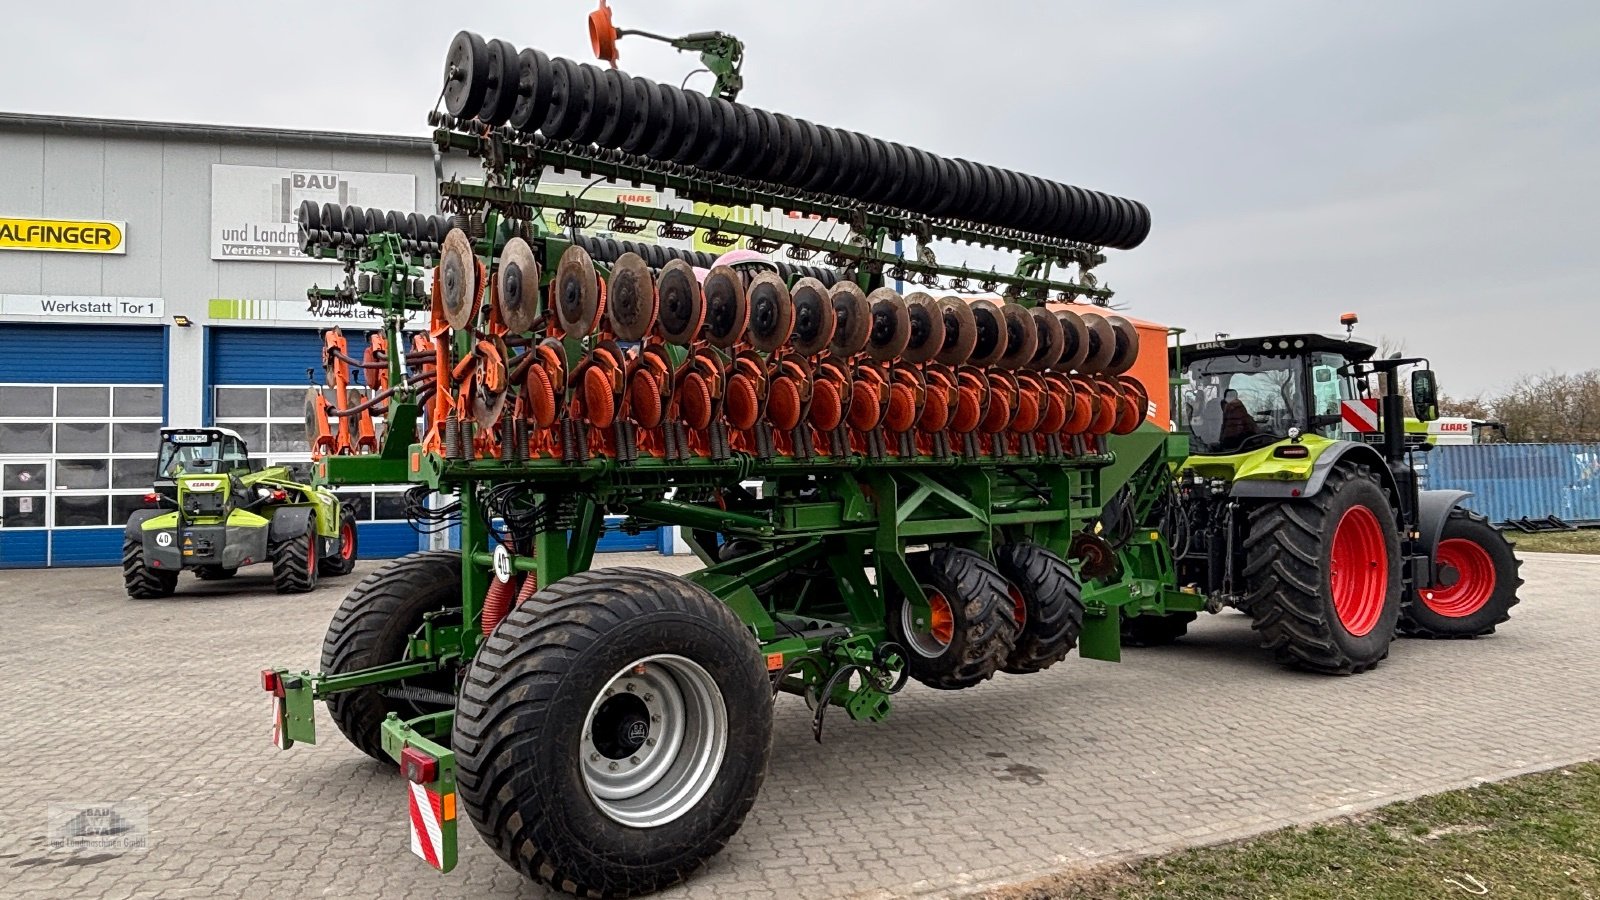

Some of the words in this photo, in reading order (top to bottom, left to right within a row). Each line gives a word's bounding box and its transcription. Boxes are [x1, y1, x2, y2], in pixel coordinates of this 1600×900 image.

[293, 174, 337, 189] BAU
[617, 194, 652, 203] CLAAS
[0, 223, 112, 245] ALFINGER
[222, 223, 248, 242] und
[254, 225, 299, 243] Landm
[223, 245, 271, 256] Vertrieb
[41, 300, 112, 313] Werkstatt
[119, 302, 144, 314] Tor
[148, 303, 154, 314] 1
[1196, 341, 1226, 350] CLAAS
[1440, 423, 1468, 431] CLAAS
[158, 534, 169, 544] 40
[498, 552, 508, 575] 40
